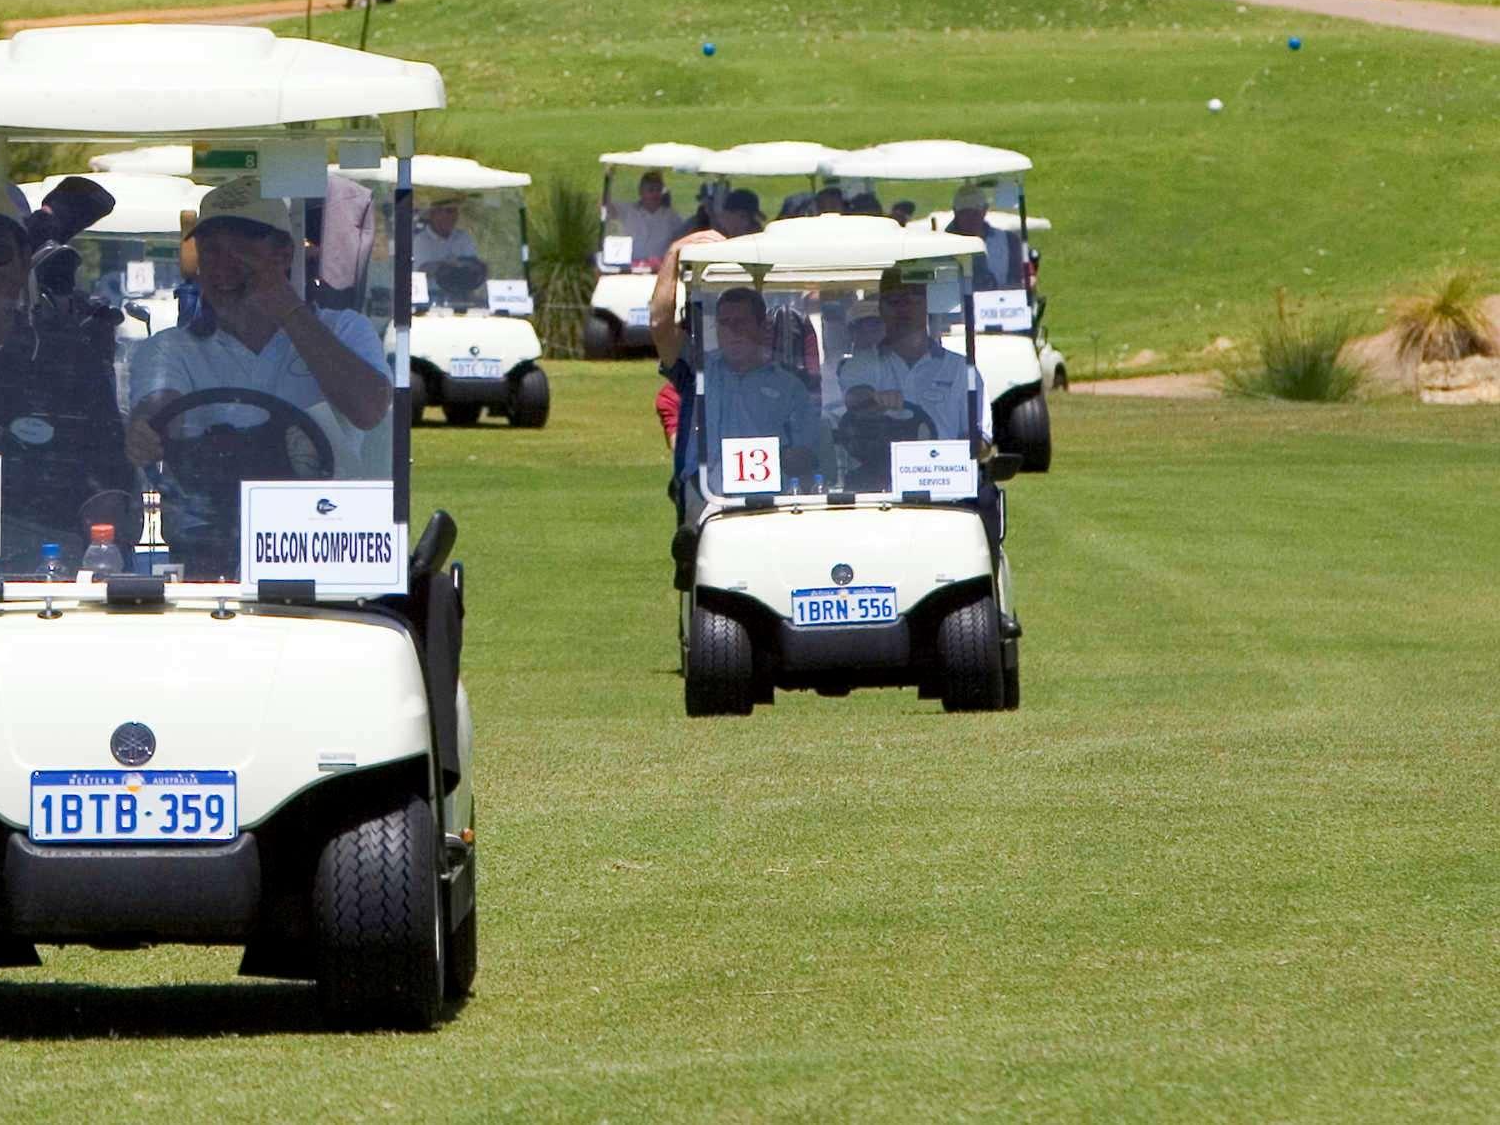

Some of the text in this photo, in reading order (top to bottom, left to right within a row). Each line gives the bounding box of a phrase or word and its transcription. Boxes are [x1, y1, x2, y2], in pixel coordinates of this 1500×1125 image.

[733, 449, 772, 482] 13
[900, 464, 968, 474] COLONIAL FINANCIAL
[919, 477, 950, 486] SERVICES
[256, 531, 392, 563] DELCON COMPUTERS
[69, 773, 198, 785] WESTERN AUSTRALIA
